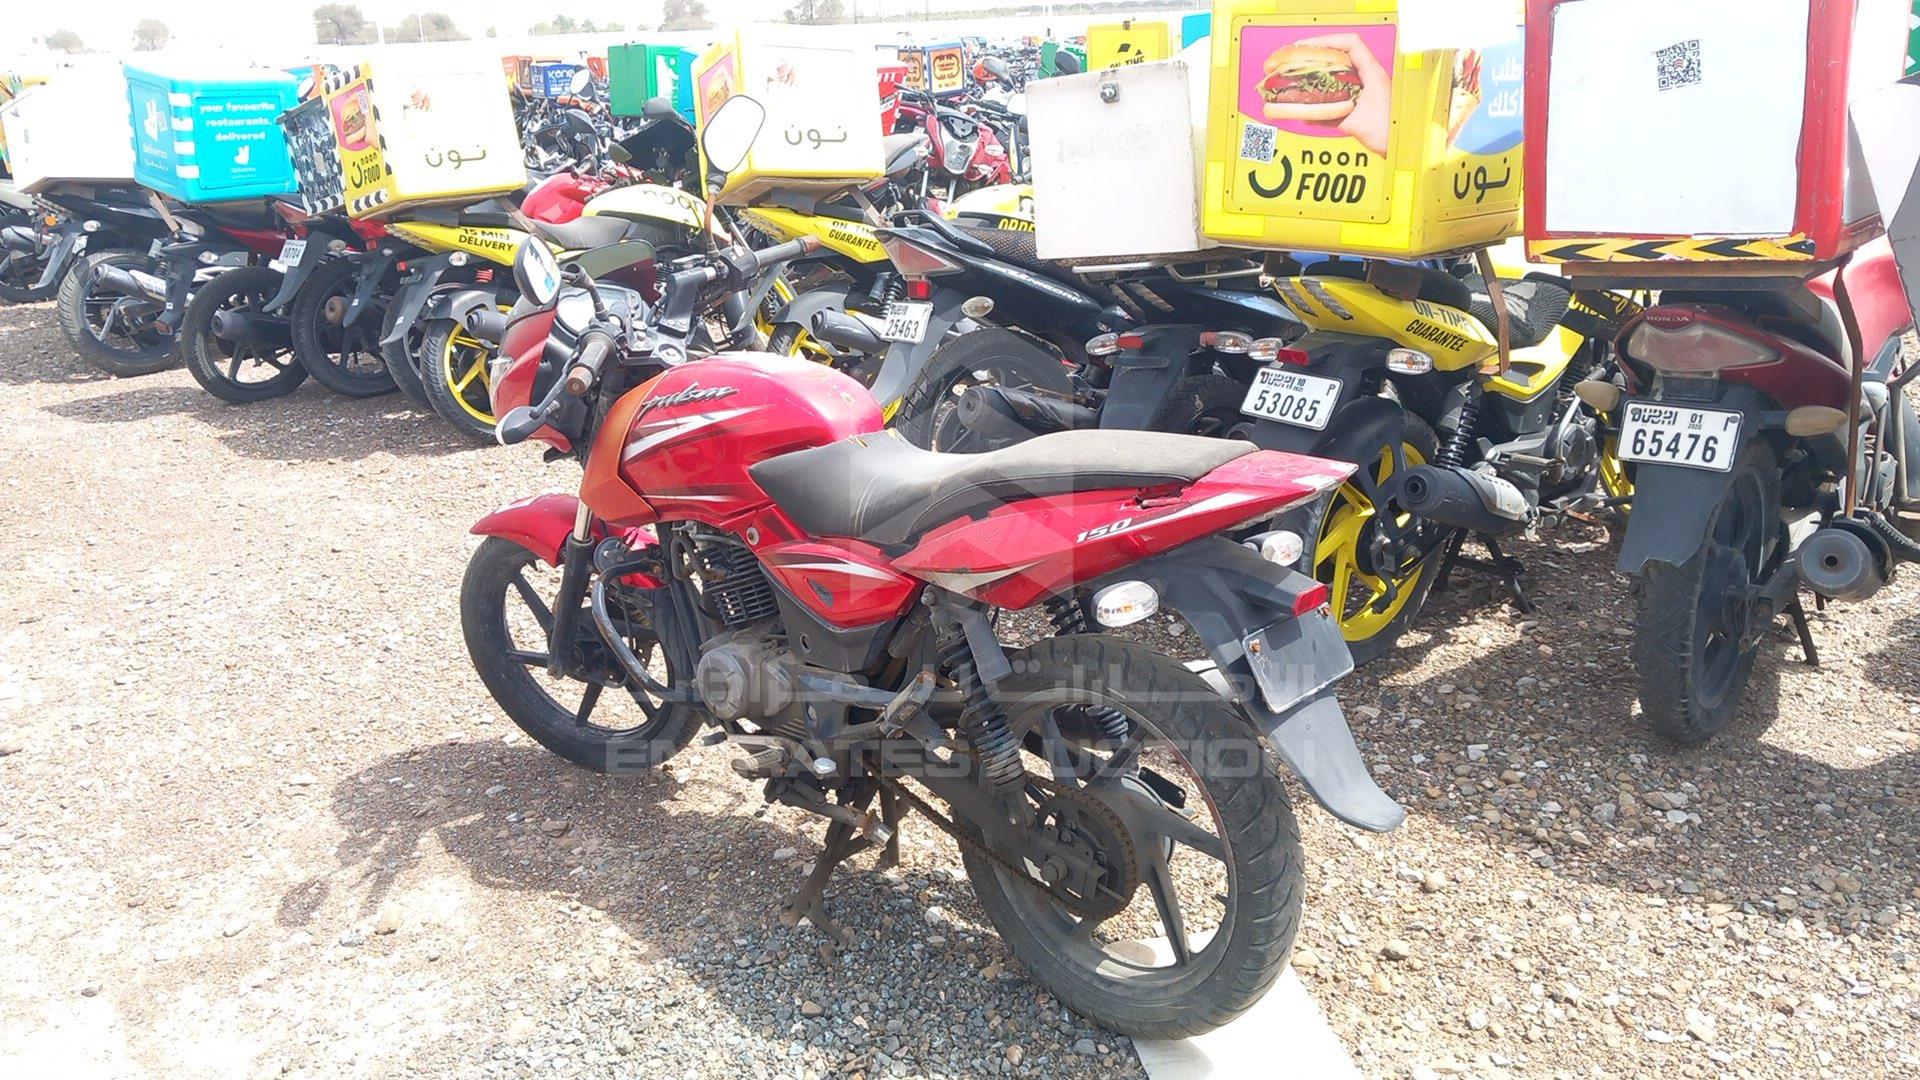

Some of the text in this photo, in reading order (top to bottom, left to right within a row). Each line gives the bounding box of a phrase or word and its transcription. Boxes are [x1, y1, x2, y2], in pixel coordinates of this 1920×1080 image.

[1124, 55, 1145, 66] TIME
[226, 101, 276, 112] favourite
[214, 130, 267, 142] delivered
[783, 123, 848, 150] نون
[360, 151, 378, 166] noon
[425, 144, 487, 170] نون
[1301, 149, 1369, 168] noon
[363, 163, 381, 186] FOOD
[1453, 156, 1511, 205] نون
[1295, 172, 1367, 204] FOOD
[458, 234, 514, 252] DELIVERY
[828, 228, 879, 251] GUARANTEE
[885, 318, 921, 340] 25463
[1405, 319, 1469, 352] GUARANTEE
[1296, 378, 1307, 388] 10
[1326, 383, 1337, 397] P
[1253, 389, 1322, 423] 53085
[1690, 412, 1705, 425] 01
[1631, 428, 1720, 464] 65476
[1076, 517, 1134, 545] 150
